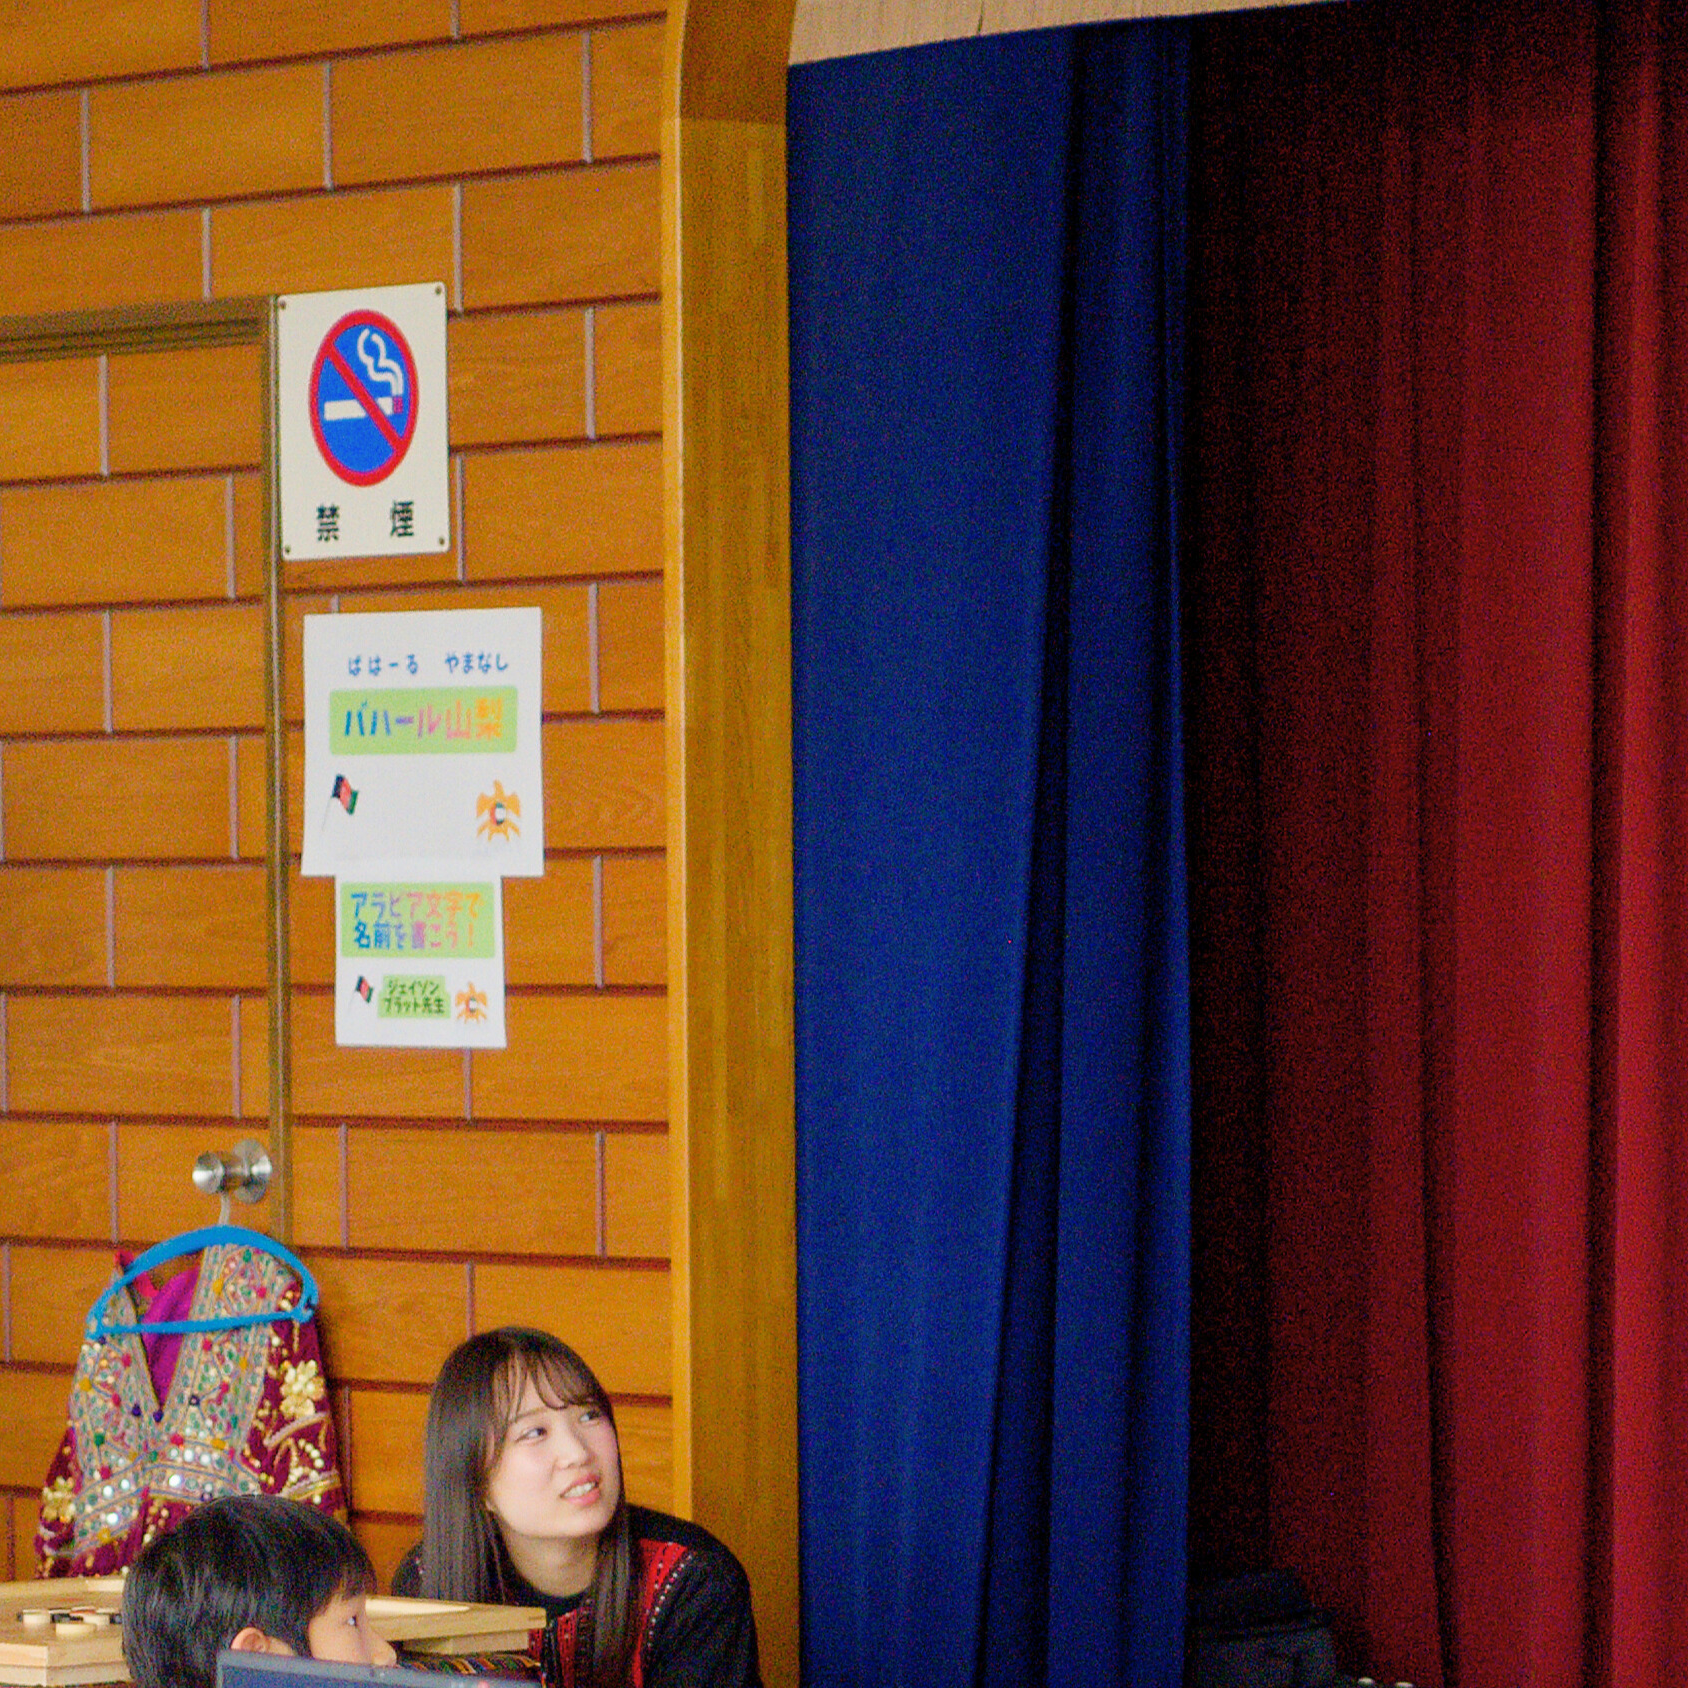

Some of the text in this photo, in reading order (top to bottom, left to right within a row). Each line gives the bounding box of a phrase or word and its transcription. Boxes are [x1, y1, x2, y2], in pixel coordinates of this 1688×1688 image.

[316, 500, 415, 542] 禁煙
[444, 651, 510, 675] やまなし
[344, 697, 504, 741] バハール山梨
